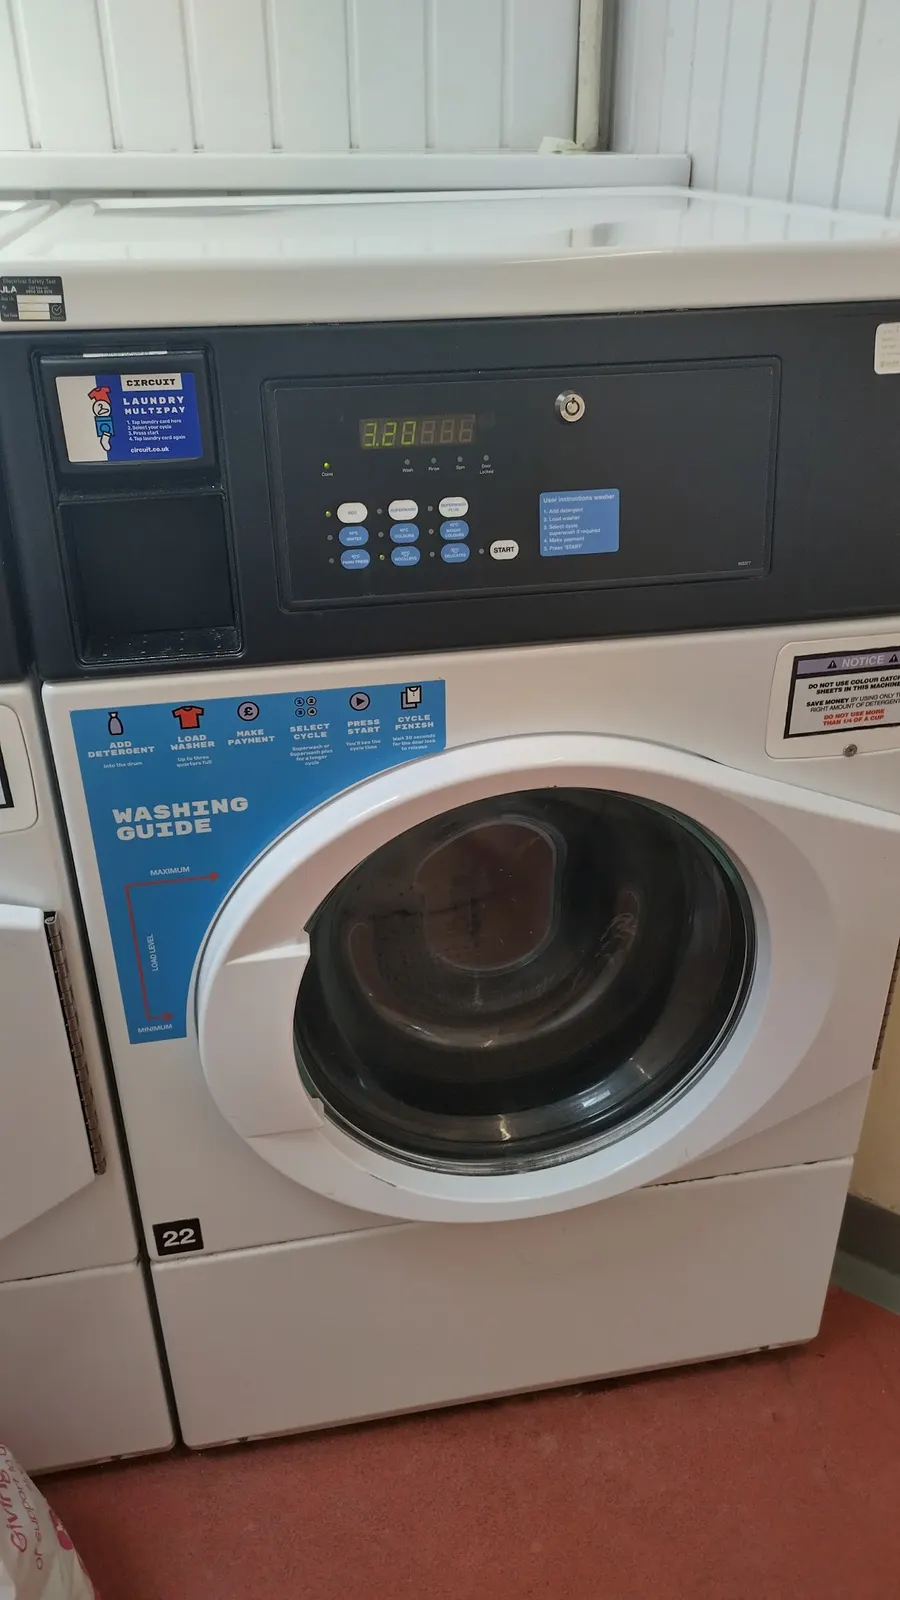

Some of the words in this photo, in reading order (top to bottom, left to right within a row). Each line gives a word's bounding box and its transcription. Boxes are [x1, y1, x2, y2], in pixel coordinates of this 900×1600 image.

[0, 285, 17, 294] JLA
[123, 396, 184, 405] LAUNDRY
[125, 407, 185, 415] MULTIPAY
[364, 421, 417, 447] 3.20
[842, 655, 885, 668] NOTICE
[850, 677, 879, 685] COLOUR
[816, 687, 843, 695] SHEETS
[825, 698, 850, 706] MONEY
[859, 694, 879, 702] USING
[829, 703, 854, 711] AMOUNT
[347, 719, 380, 728] PRESS
[397, 715, 431, 723] CYCLE
[289, 723, 330, 733] SELECT
[347, 726, 381, 735] START
[395, 721, 434, 731] FINISH
[236, 729, 265, 737] MAKE
[293, 732, 328, 740] CYCLE
[177, 735, 207, 743] LOAD
[227, 736, 275, 746] PAYMENT
[109, 741, 132, 749] ADD
[170, 741, 215, 751] WASHER
[87, 746, 155, 758] DETERGENT
[112, 797, 248, 824] WASHING
[116, 818, 212, 841] GUIDE
[150, 866, 190, 876] MAXIMUM
[146, 933, 156, 954] LEVEL
[149, 954, 159, 972] LOAD
[138, 1024, 172, 1033] MINIMUM
[162, 1228, 196, 1248] 22
